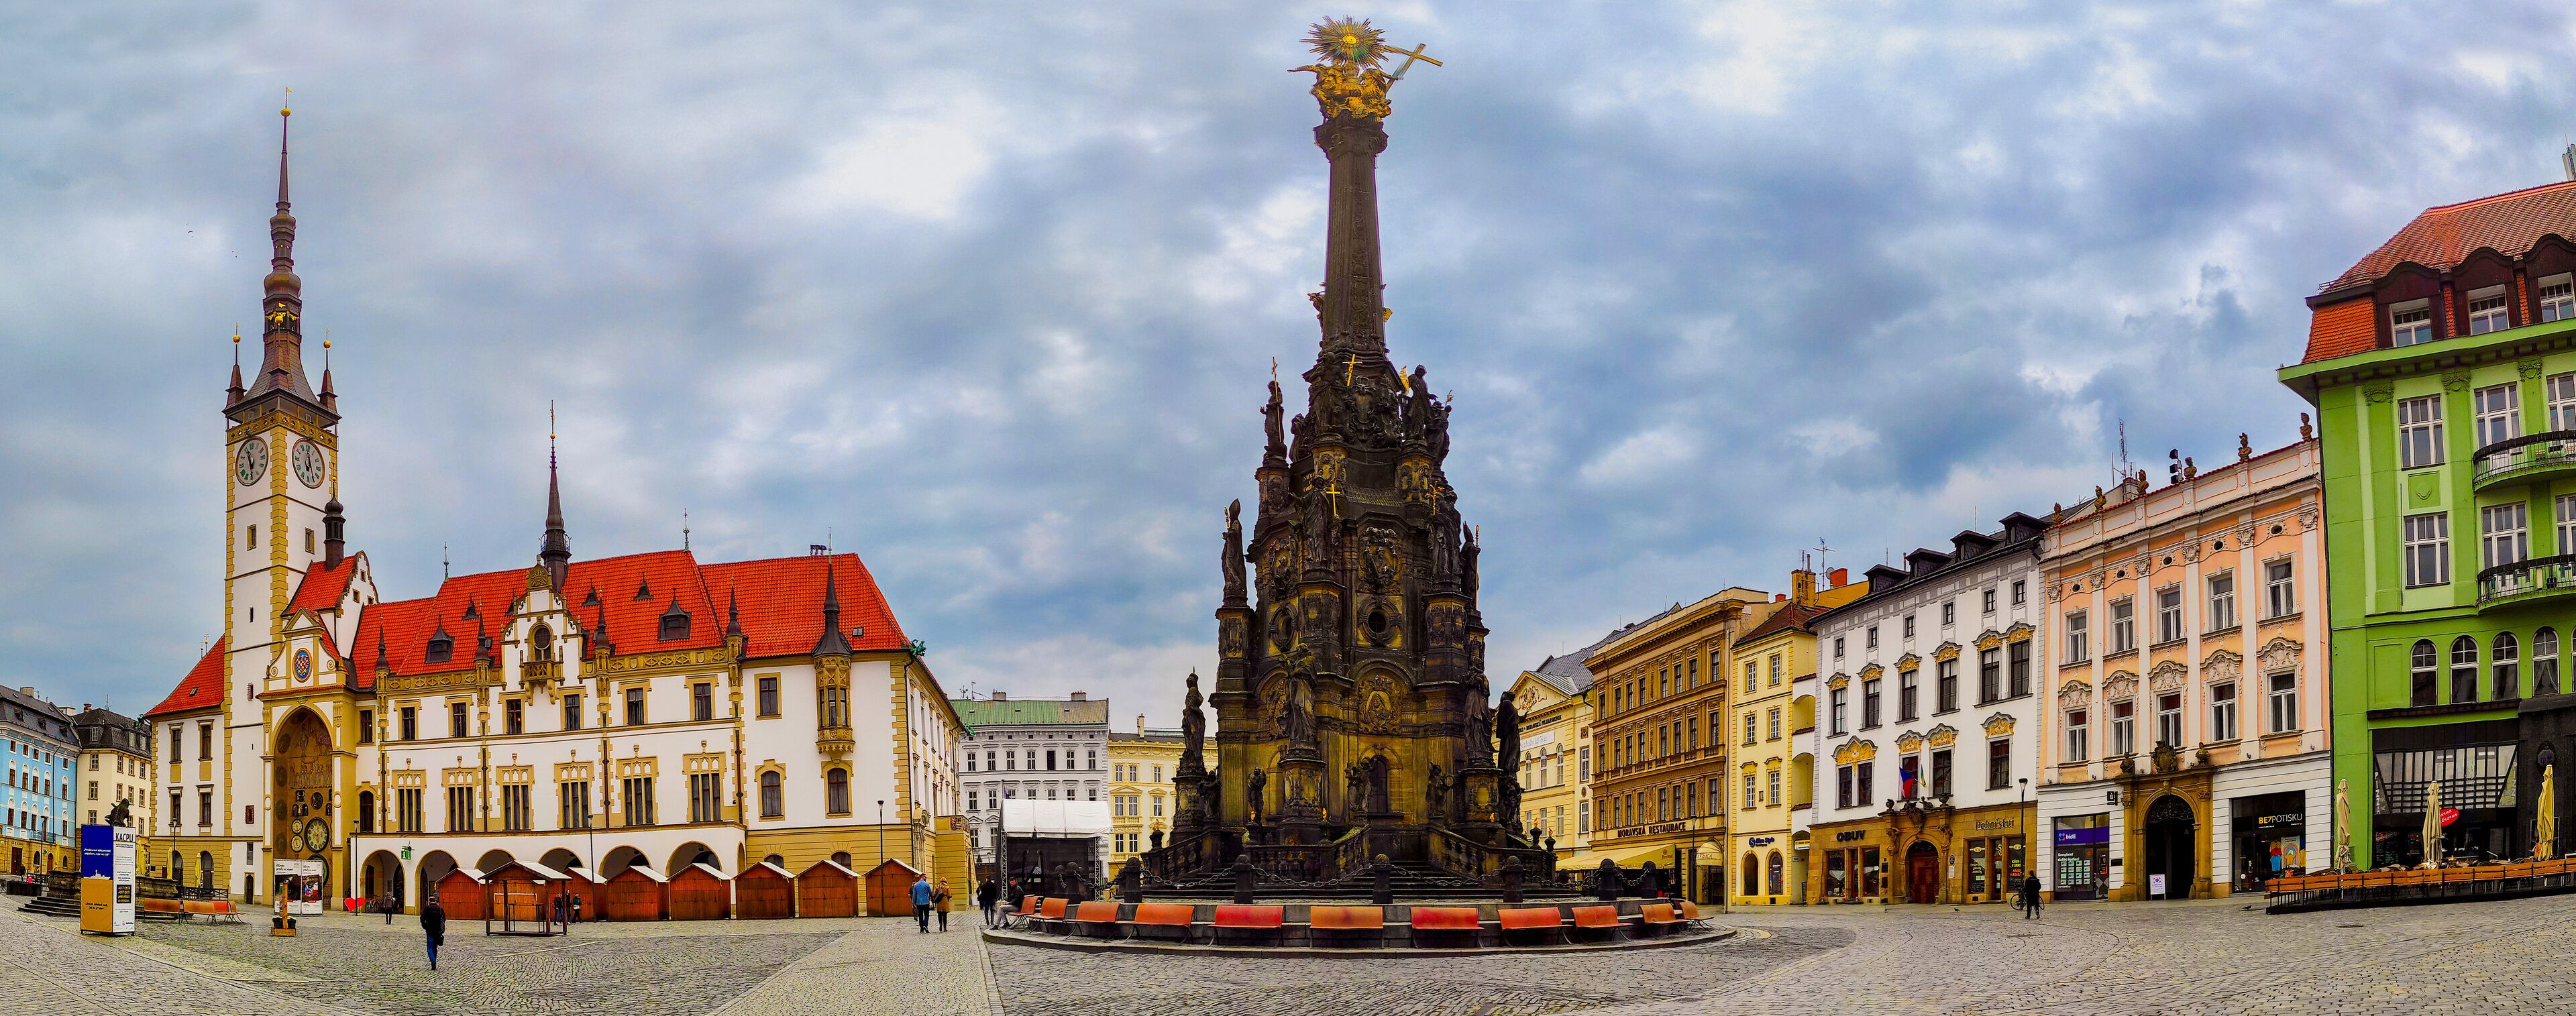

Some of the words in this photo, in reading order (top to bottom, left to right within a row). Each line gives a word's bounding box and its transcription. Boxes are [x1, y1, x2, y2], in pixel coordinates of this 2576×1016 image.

[1617, 825, 1646, 838] MORAVSKÁ
[1648, 822, 1686, 835] RESTAURACE
[1836, 830, 1866, 842] OBUV
